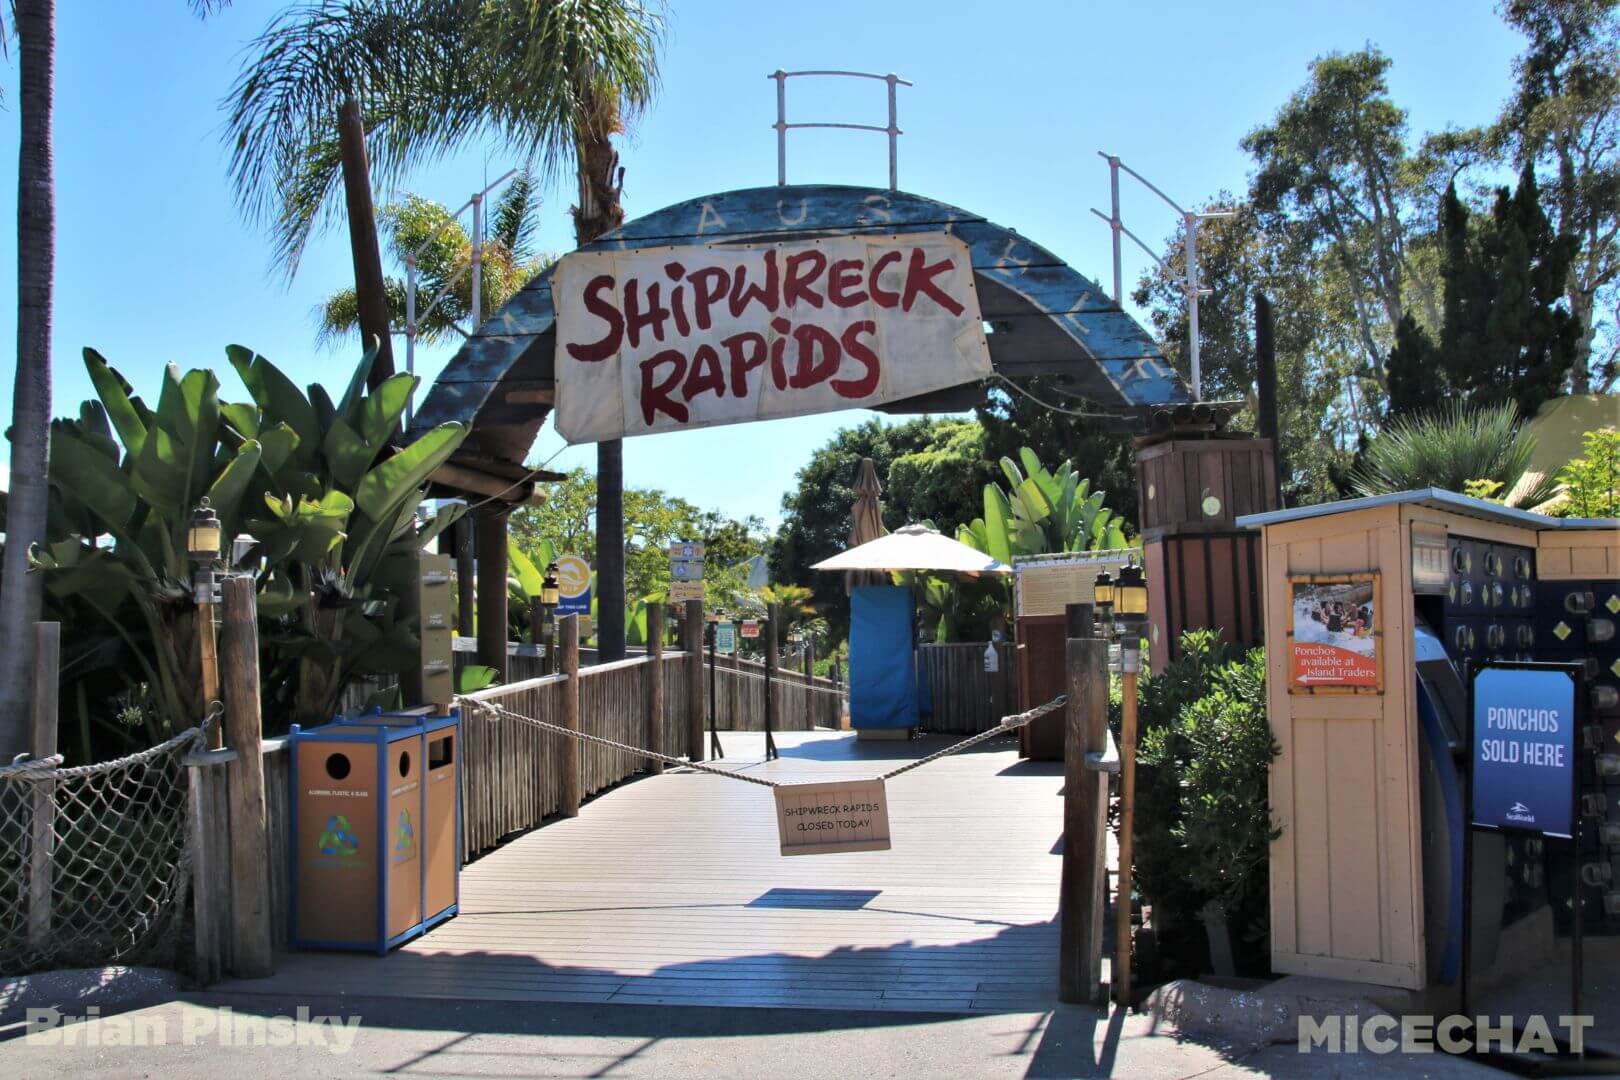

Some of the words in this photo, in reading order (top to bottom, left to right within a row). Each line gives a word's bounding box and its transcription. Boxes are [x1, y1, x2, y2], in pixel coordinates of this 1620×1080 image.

[1295, 645, 1336, 656] Ponchos
[1301, 656, 1341, 666] available
[1345, 657, 1355, 666] at
[1307, 667, 1335, 677] Island
[1338, 667, 1376, 677] Traders
[1487, 706, 1560, 733] PONCHOS
[1481, 738, 1520, 764] SOLD
[1523, 741, 1565, 768] HERE
[784, 804, 841, 817] SHIPWRECK
[842, 803, 880, 814] RAPIDS
[796, 821, 834, 832] CLOSED
[837, 819, 871, 829] TODAY
